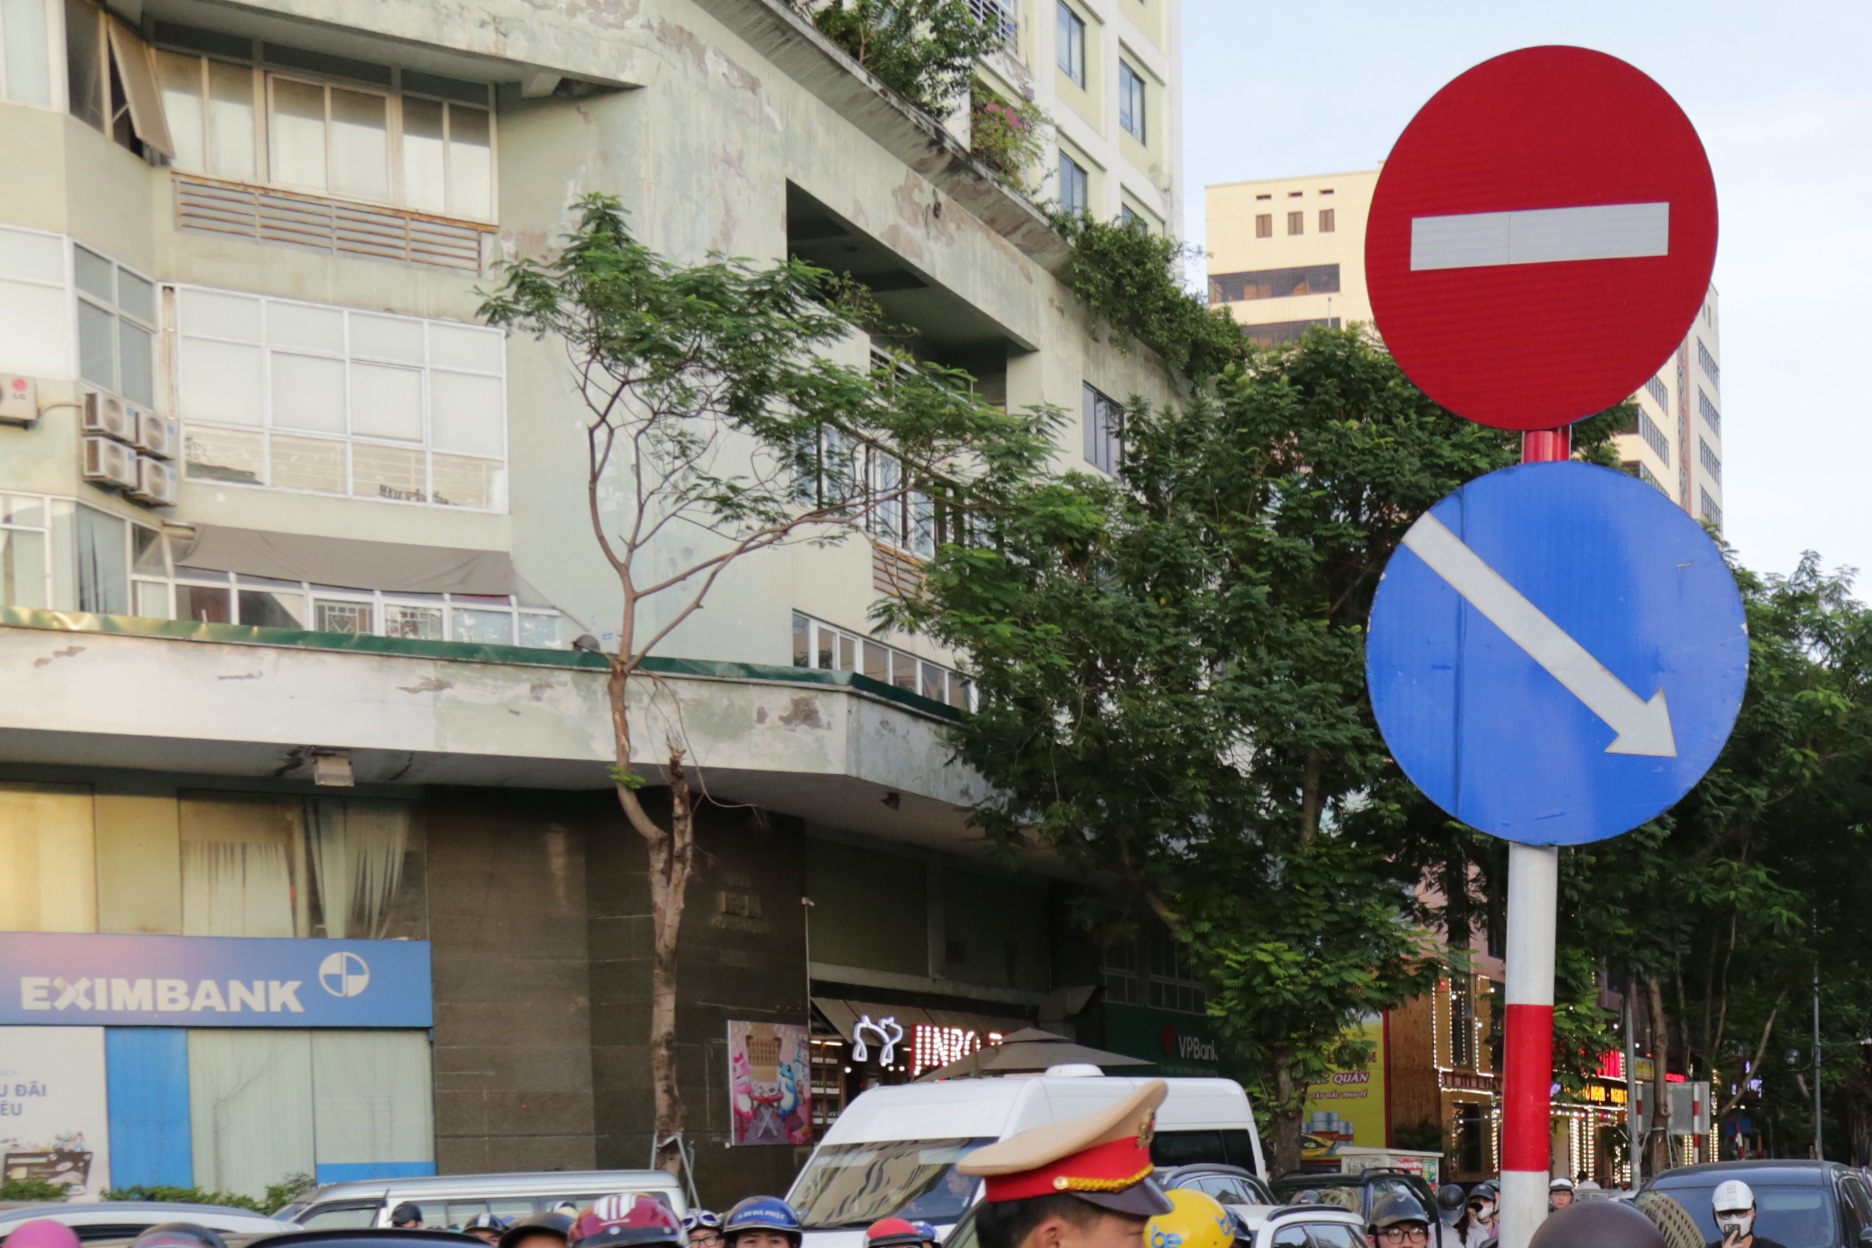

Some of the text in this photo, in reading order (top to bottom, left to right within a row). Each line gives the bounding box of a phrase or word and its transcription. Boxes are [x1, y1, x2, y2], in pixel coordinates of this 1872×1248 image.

[20, 976, 305, 1013] EXIMBANK
[1179, 1035, 1219, 1061] VPBank
[1333, 1069, 1369, 1086] QUÁN
[15, 1081, 47, 1098] ĐÃI
